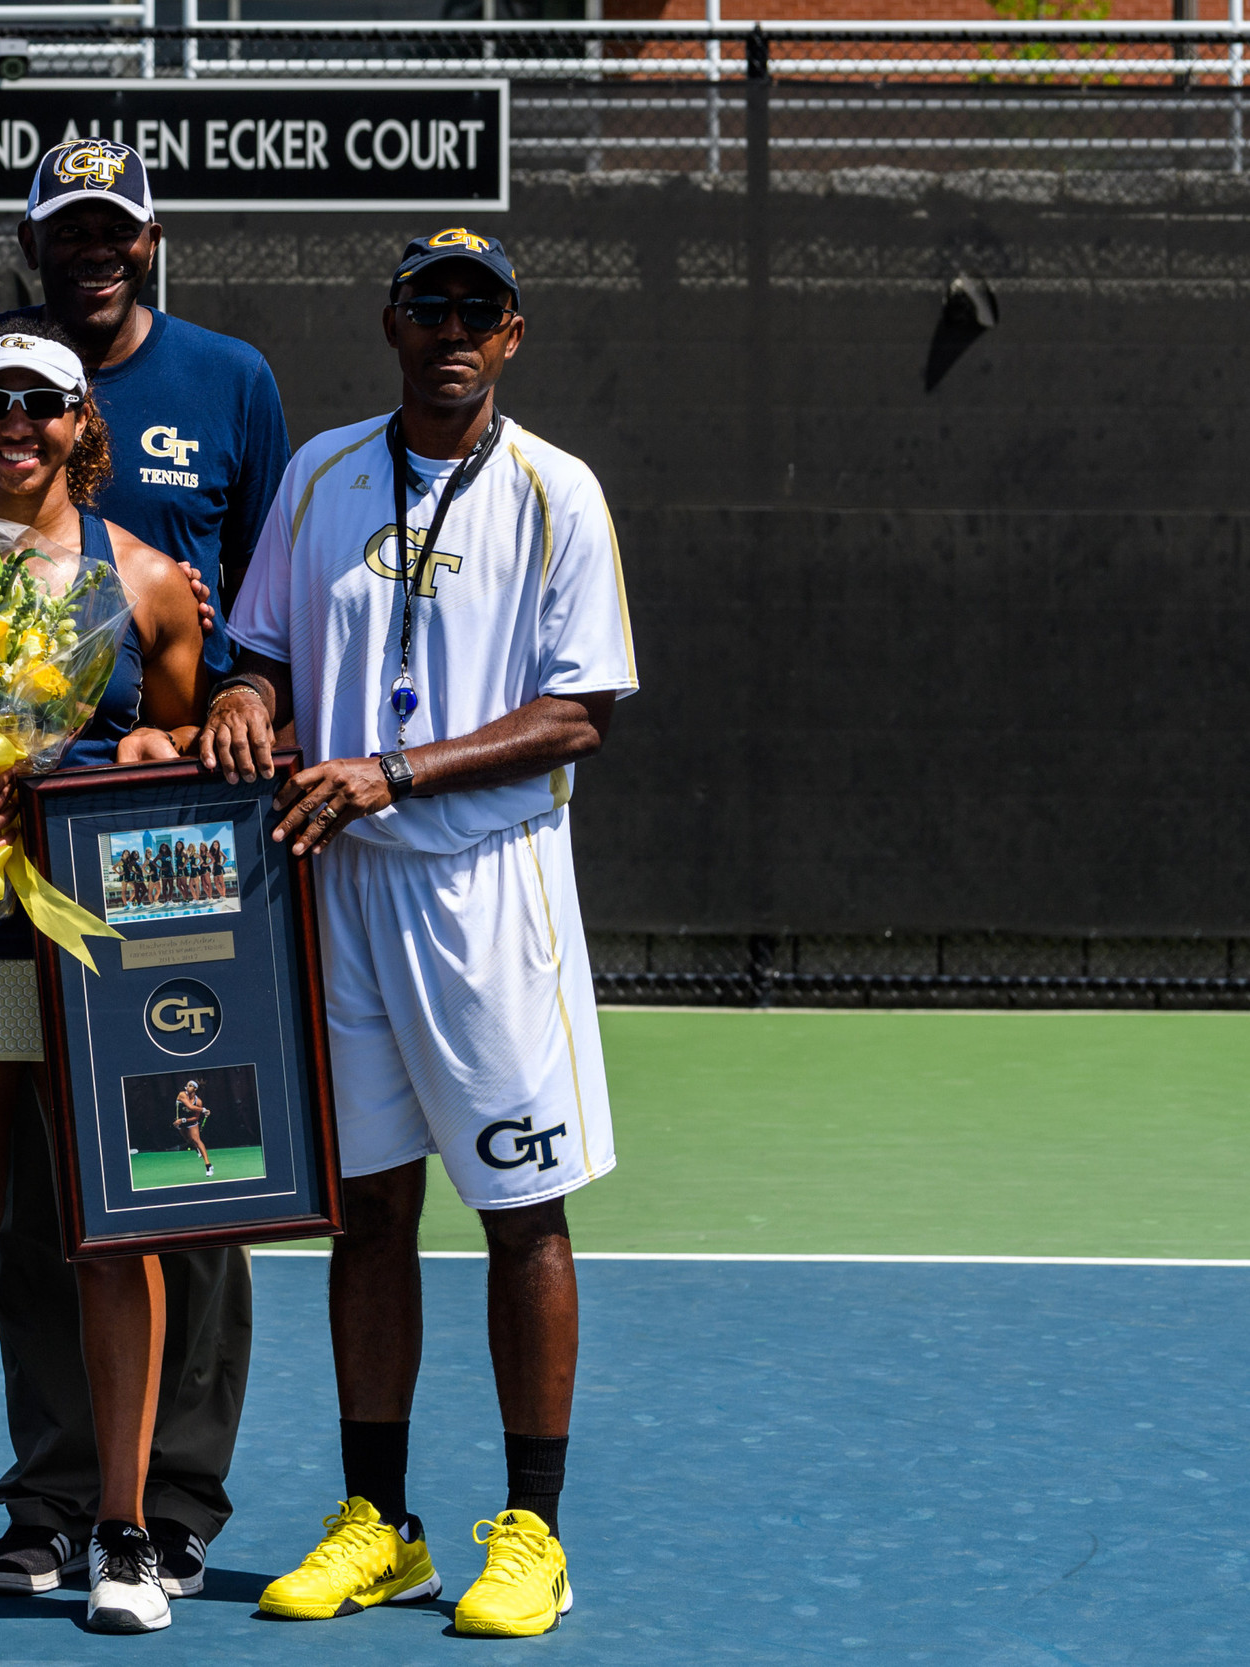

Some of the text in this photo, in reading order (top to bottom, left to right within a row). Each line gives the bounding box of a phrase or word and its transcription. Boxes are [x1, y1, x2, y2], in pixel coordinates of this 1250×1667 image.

[205, 119, 330, 171] ECKER
[344, 118, 486, 171] COURT
[61, 146, 125, 184] GT
[428, 227, 490, 253] GT
[0, 336, 35, 350] GT
[140, 425, 199, 467] GT
[139, 467, 199, 489] TENNIS
[363, 523, 463, 598] GT
[151, 996, 215, 1034] GT
[475, 1114, 567, 1173] GT
